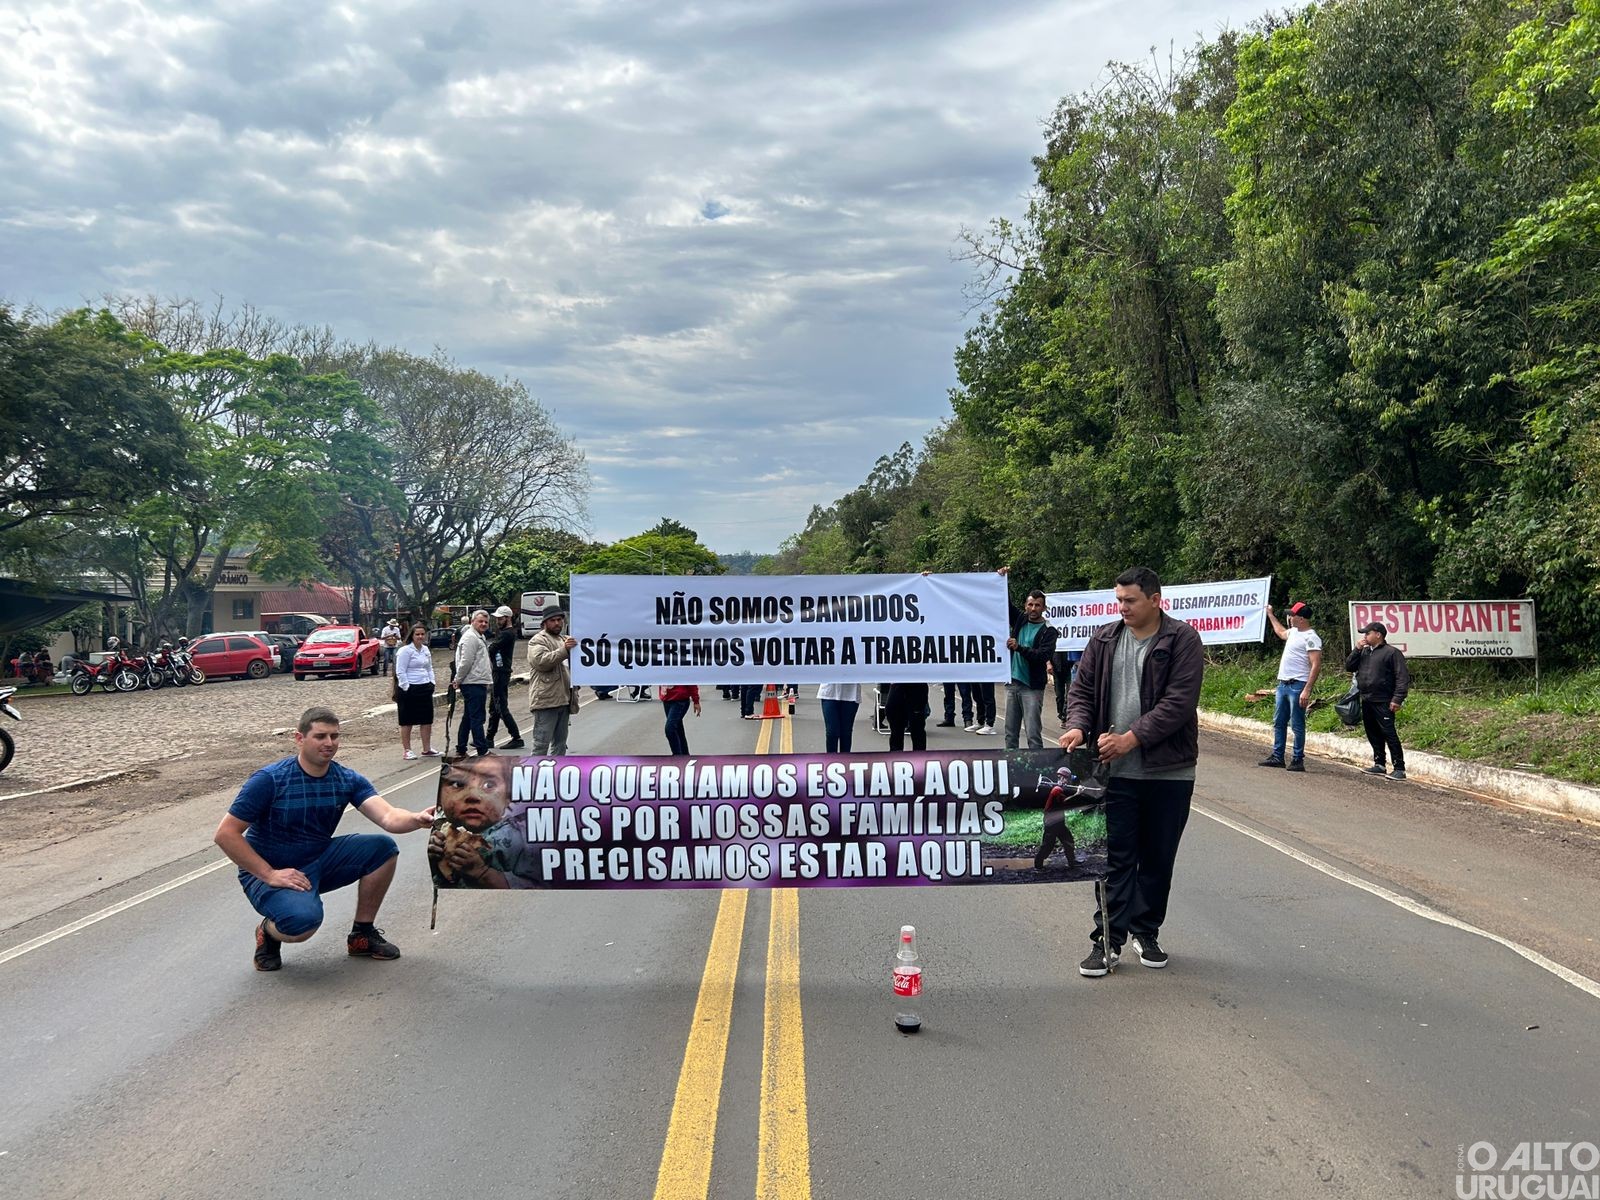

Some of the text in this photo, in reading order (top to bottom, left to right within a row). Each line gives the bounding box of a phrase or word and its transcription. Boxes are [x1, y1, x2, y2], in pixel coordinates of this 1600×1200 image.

[655, 590, 925, 625] NÃO SOMOS BANDIDOS,
[1045, 605, 1077, 619] SOMOS
[1079, 603, 1104, 617] 1.500
[1173, 593, 1260, 611] DESAMPARADOS.
[1355, 603, 1522, 634] RESTAURANTE
[1057, 624, 1069, 639] SÓ
[580, 633, 1002, 670] SÓ QUEREMOS VOLTAR A TRABALHAR.
[1450, 644, 1514, 656] PANORÂMICO
[511, 759, 1020, 803] NÃO QUERÍAMOS ESTAR AQUI,
[527, 796, 1005, 843] MAS POR NOSSAS FAMÍLIAS
[541, 840, 993, 881] PRECISAMOS ESTAR AQUI.
